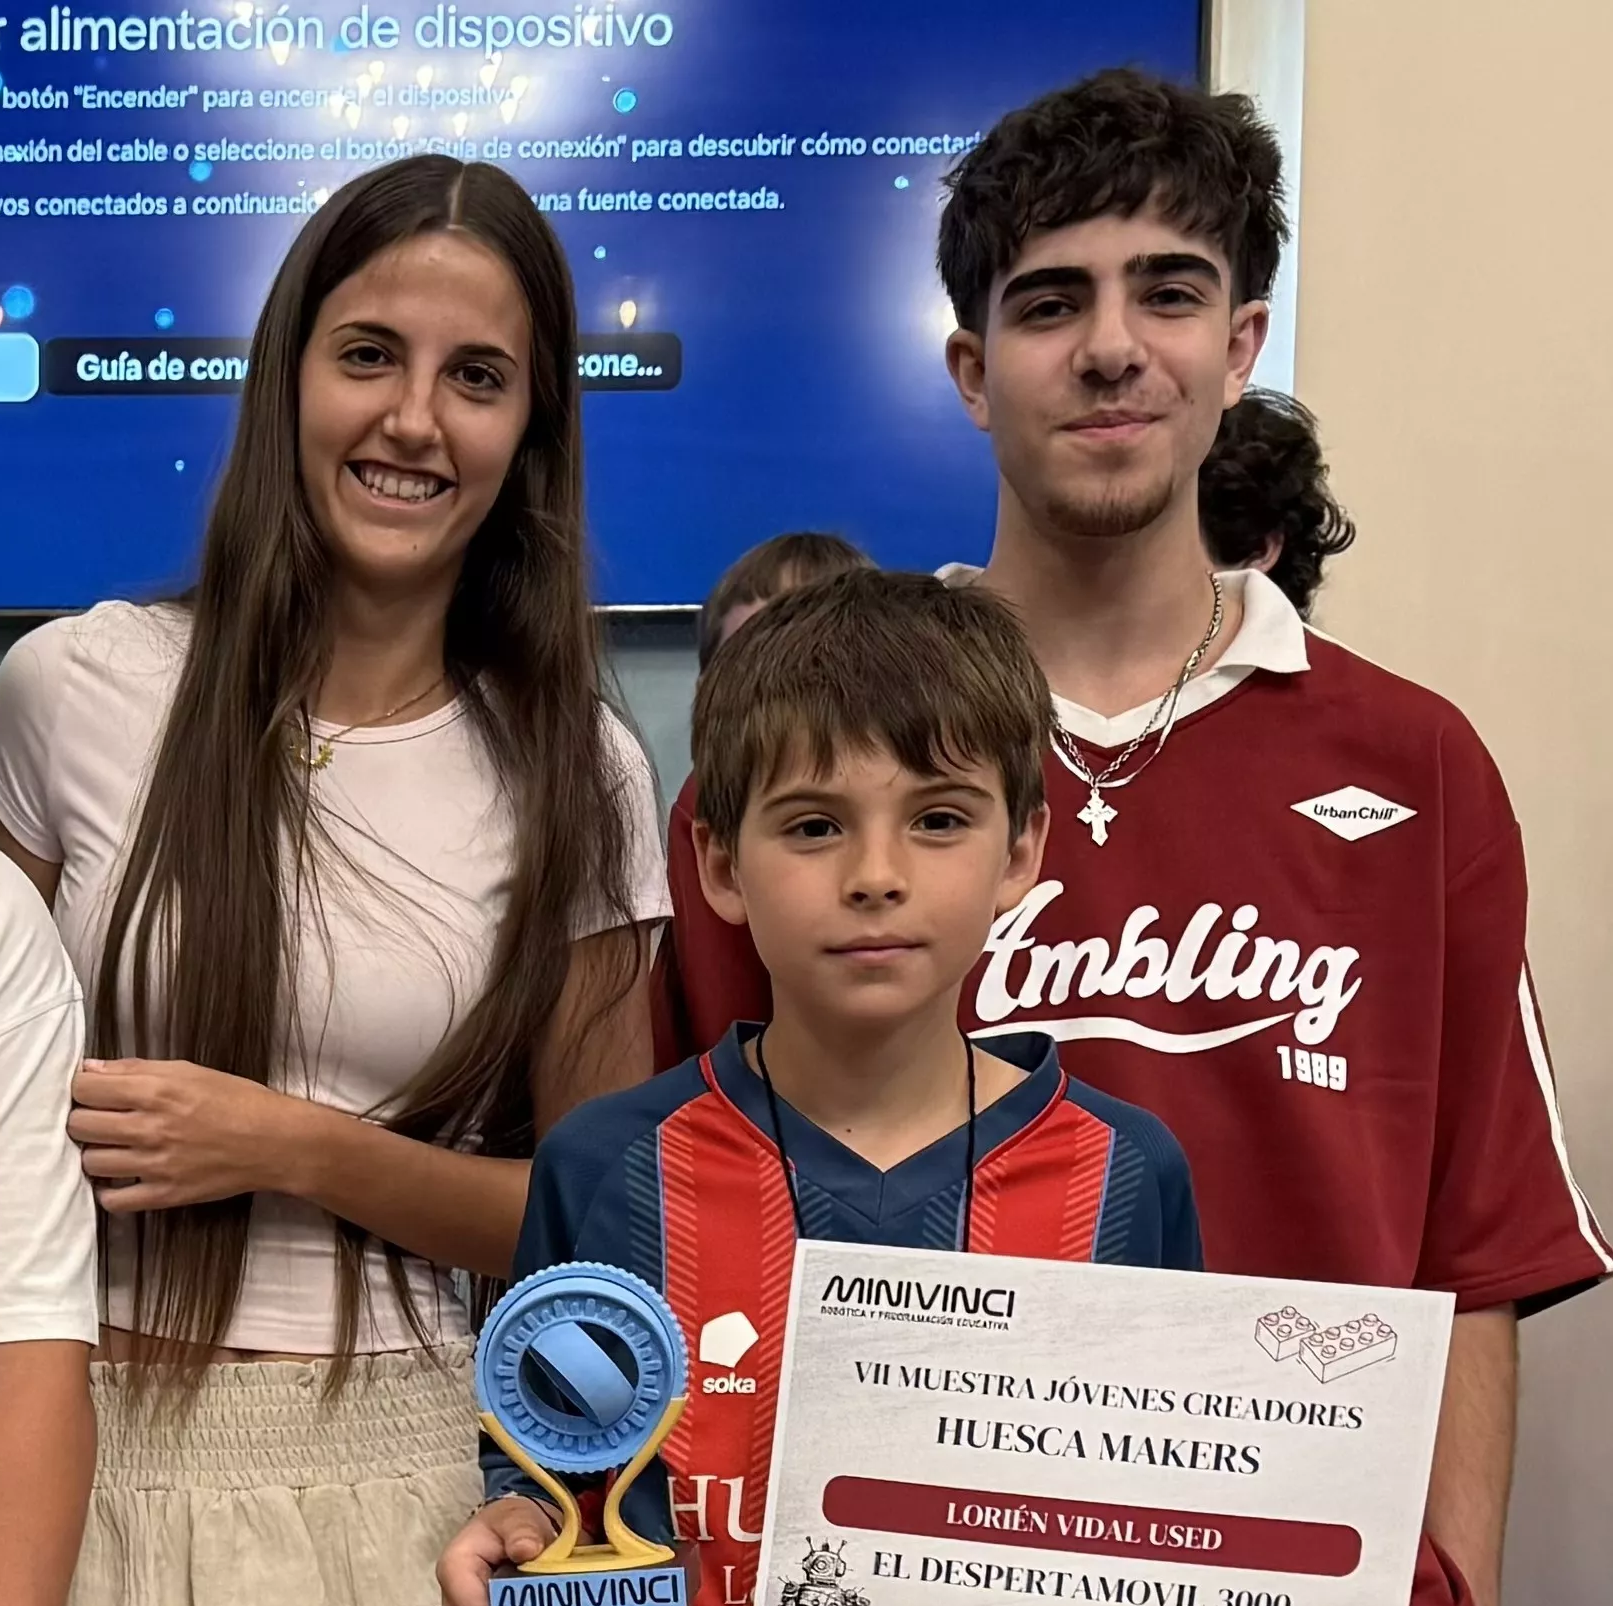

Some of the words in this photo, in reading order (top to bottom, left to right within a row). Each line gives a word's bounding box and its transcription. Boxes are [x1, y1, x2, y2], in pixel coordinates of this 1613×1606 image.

[21, 2, 324, 52] alimentación
[340, 6, 399, 49] de
[415, 4, 673, 57] dispositivo
[2, 85, 69, 110] botón
[74, 84, 198, 110] "Encender"
[203, 88, 253, 112] para
[259, 85, 364, 108] encener
[373, 84, 393, 107] el
[67, 138, 102, 162] del
[107, 138, 167, 162] cable
[172, 145, 190, 161] o
[194, 138, 315, 162] seleccione
[320, 137, 340, 161] el
[346, 137, 413, 160] botón
[482, 136, 512, 159] de
[518, 135, 626, 159] conexión"
[632, 139, 683, 163] para
[688, 134, 795, 158] descubrir
[800, 132, 867, 156] cómo
[35, 192, 167, 216] conectados
[172, 198, 188, 216] a
[577, 187, 653, 212] fuente
[658, 187, 785, 212] conectada.
[76, 350, 142, 382] Guía
[147, 350, 185, 382] de
[975, 879, 1362, 1046] Ambling
[1276, 1045, 1347, 1092] 1989
[822, 1275, 1016, 1318] MINIVINCI
[956, 1317, 1009, 1332] EDUCATIVA
[702, 1372, 757, 1395] soka
[855, 1360, 890, 1388] VII
[896, 1364, 1036, 1401] MUESTRA
[1043, 1374, 1176, 1415] JÓVENES
[1183, 1391, 1364, 1430] CREADORES
[936, 1416, 1086, 1461] HUESCA
[1097, 1432, 1262, 1476] MAKERS
[946, 1499, 1049, 1535] LORIÉN
[1054, 1512, 1142, 1545] VIDAL
[1147, 1521, 1223, 1553] USED
[871, 1551, 912, 1580] EL
